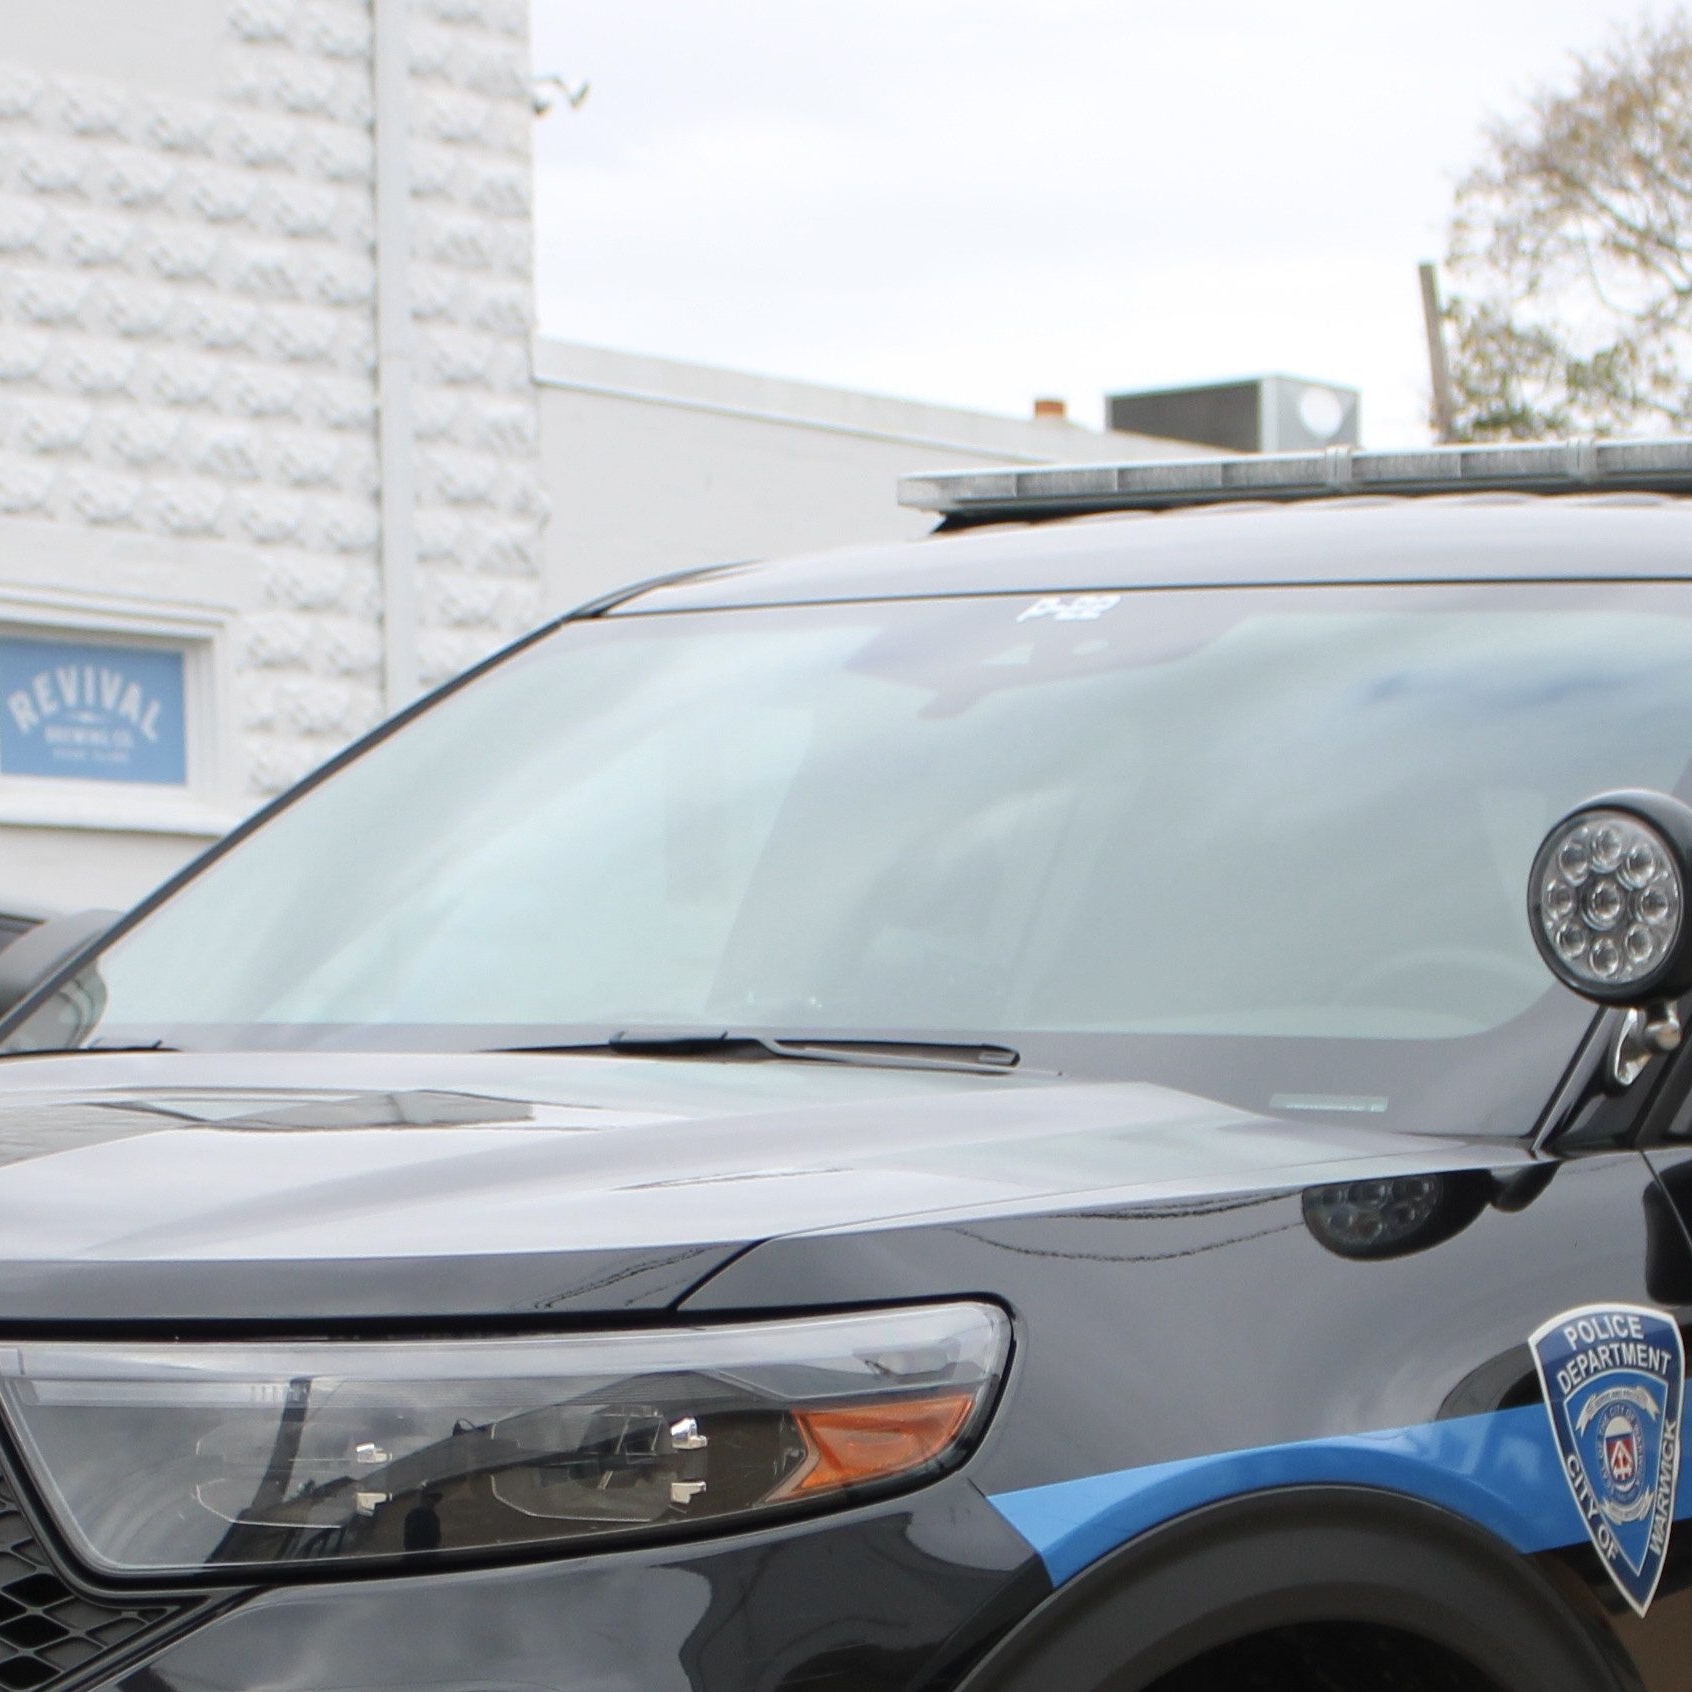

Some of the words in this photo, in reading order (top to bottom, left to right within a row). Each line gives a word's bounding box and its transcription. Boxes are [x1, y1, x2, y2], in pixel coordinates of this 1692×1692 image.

[8, 663, 161, 743] REVIVAL
[1557, 1342, 1672, 1395] DEPARTMENT
[1564, 1315, 1644, 1350] POLICE
[1564, 1452, 1599, 1519] CITY
[1598, 1521, 1619, 1561] OF
[1649, 1419, 1677, 1556] WARWICK
